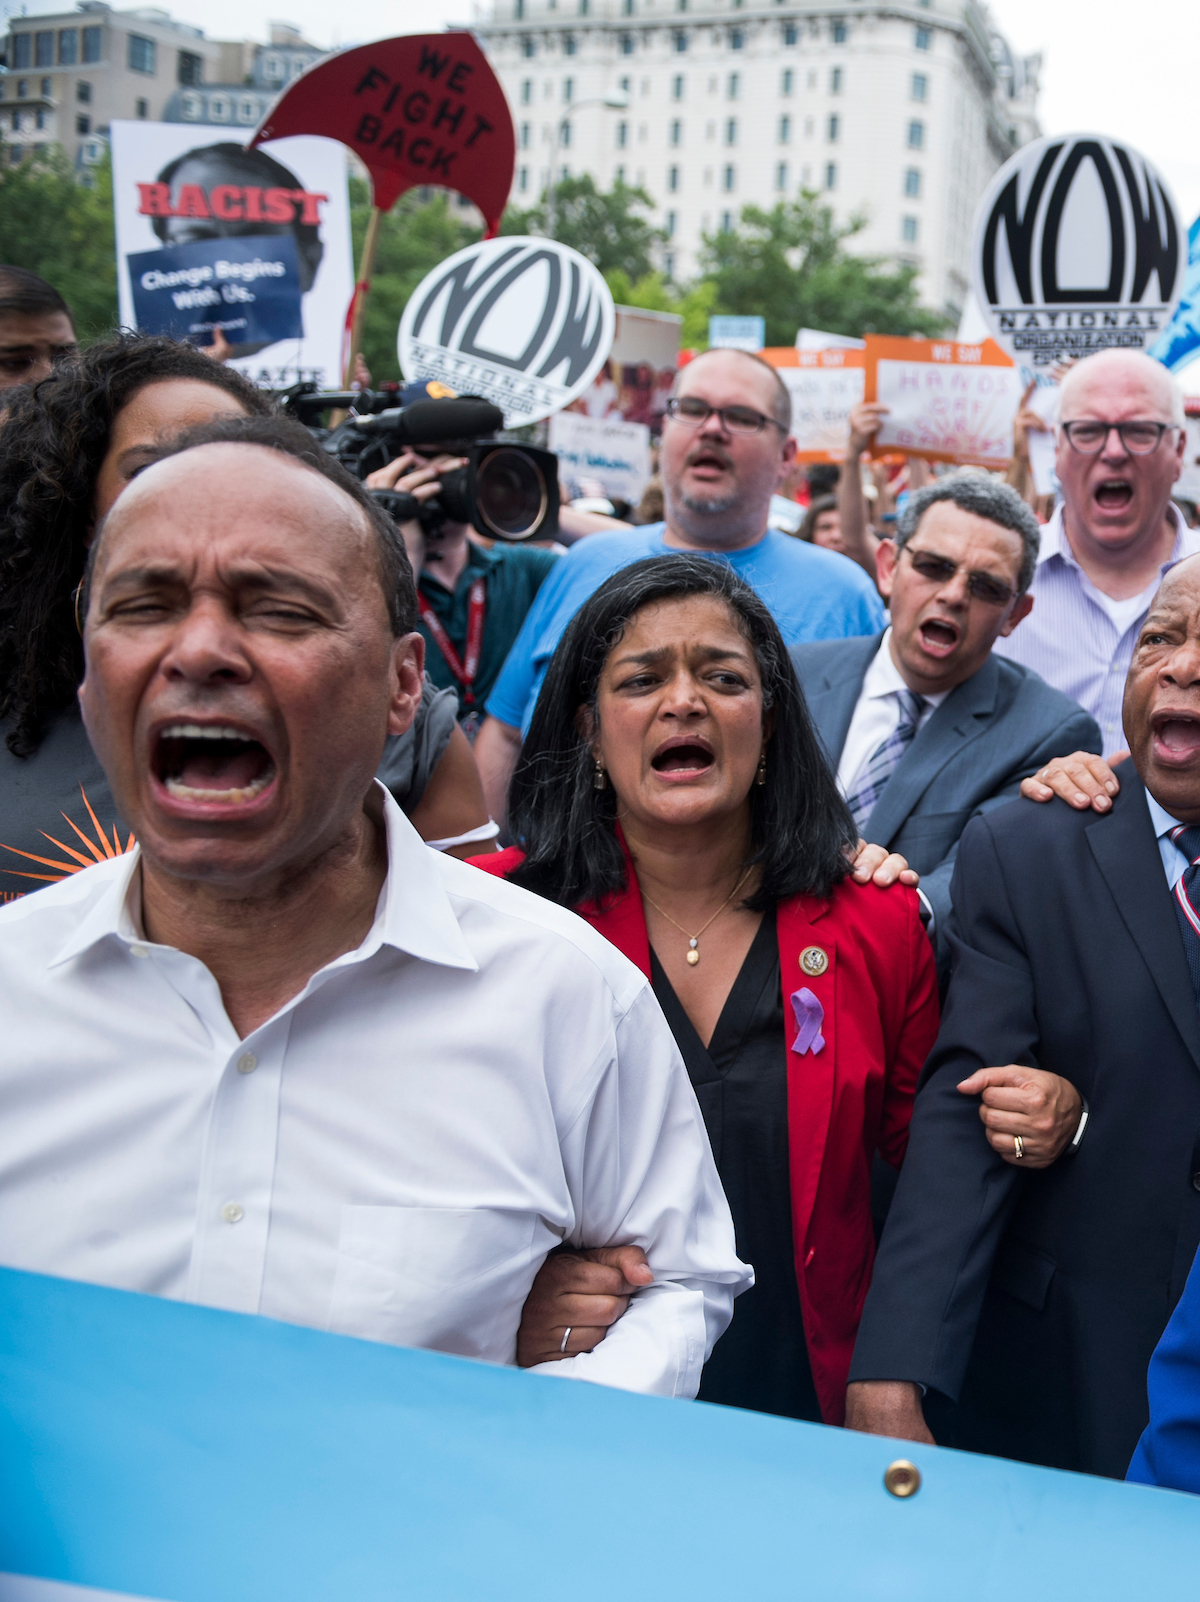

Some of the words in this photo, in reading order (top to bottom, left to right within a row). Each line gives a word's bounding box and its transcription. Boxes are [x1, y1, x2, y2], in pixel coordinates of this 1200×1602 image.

[417, 46, 474, 94] WE
[354, 65, 494, 148] FIGHT
[355, 112, 457, 177] BACK
[136, 180, 328, 225] RACIST
[979, 140, 1178, 304] NOW
[140, 265, 214, 291] Change
[214, 257, 286, 281] Begins
[172, 285, 221, 311] With
[221, 284, 256, 304] Us.
[412, 246, 604, 388] NOW
[1000, 312, 1158, 328] NATIONAL
[932, 345, 953, 361] WE
[957, 346, 982, 362] SAY
[1012, 333, 1143, 350] ORGANIZATION
[411, 346, 552, 406] NATIONAL
